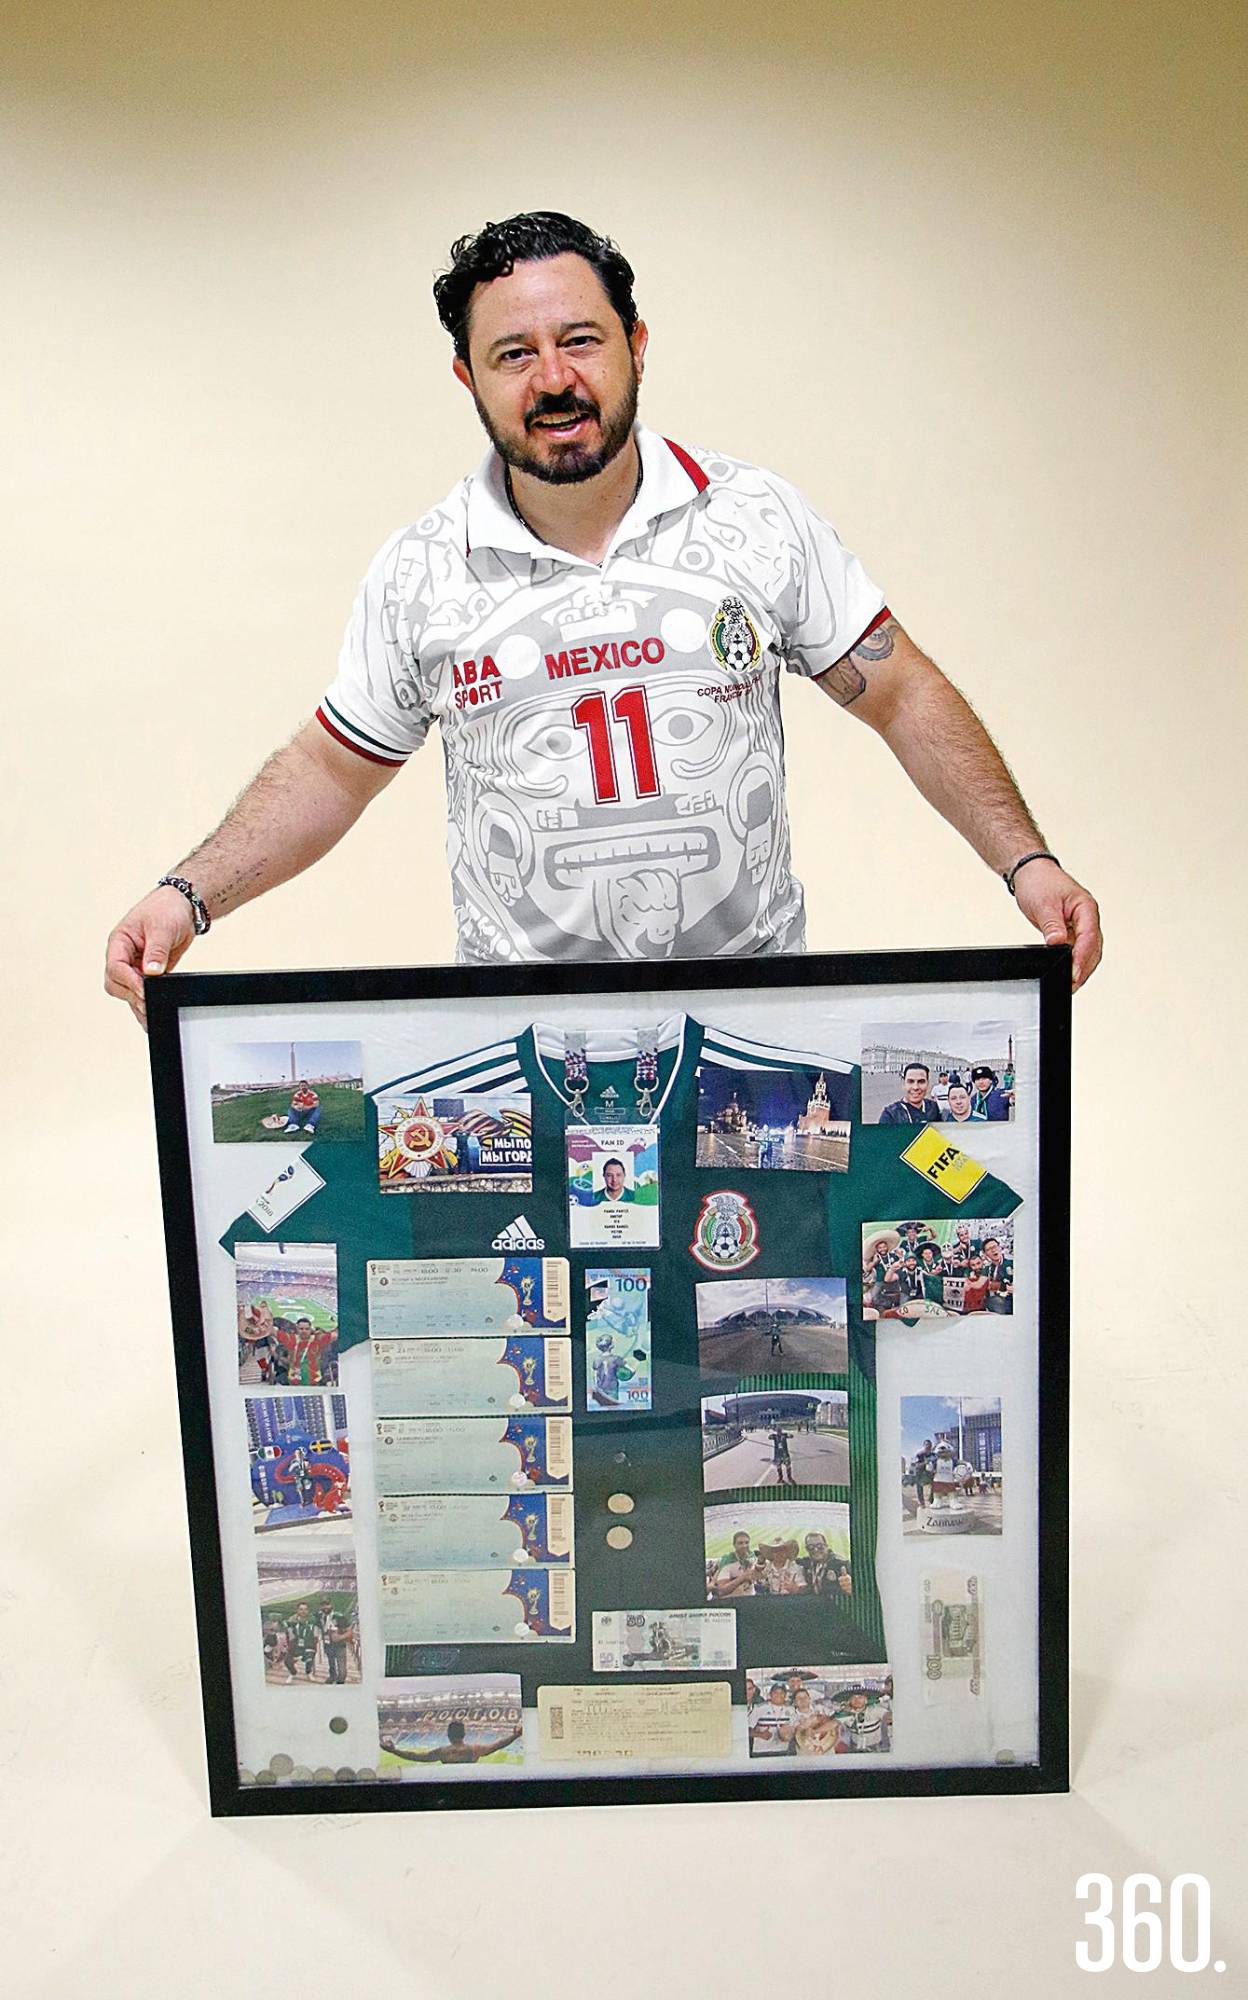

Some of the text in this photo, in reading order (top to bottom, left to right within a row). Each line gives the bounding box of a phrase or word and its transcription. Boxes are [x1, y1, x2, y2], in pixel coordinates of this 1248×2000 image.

[544, 637, 665, 680] MEXICO
[452, 655, 502, 688] ABA
[454, 681, 502, 709] SPORT
[697, 685, 722, 696] COPA
[571, 685, 661, 805] 11
[927, 1147, 960, 1179] FIFA
[491, 1237, 545, 1250] adidas
[615, 1278, 647, 1292] 100
[626, 1390, 648, 1401] 100
[626, 1614, 645, 1627] 50
